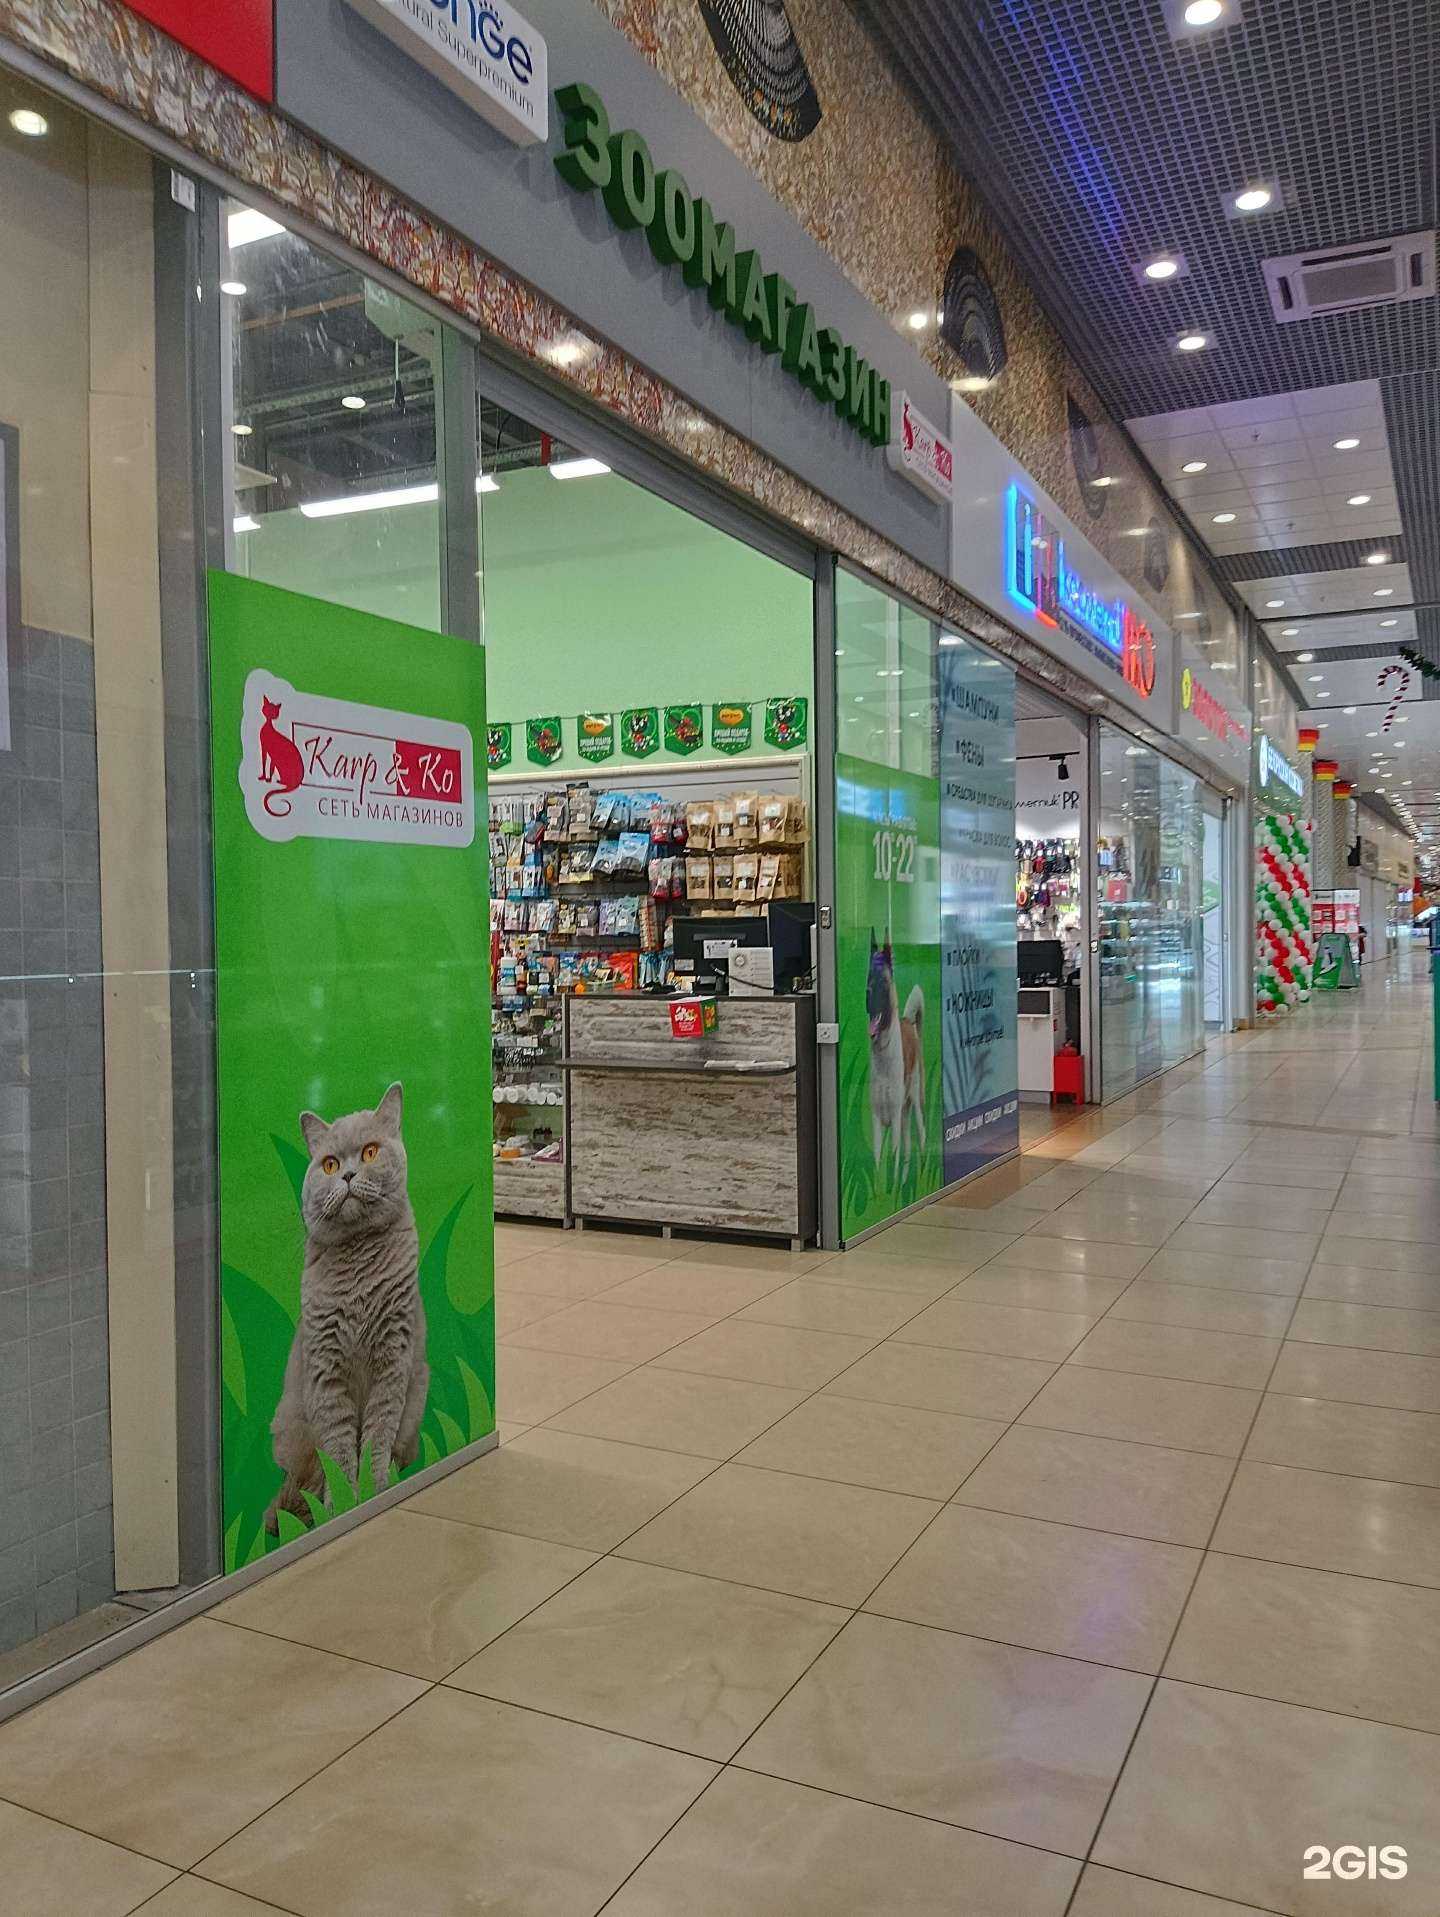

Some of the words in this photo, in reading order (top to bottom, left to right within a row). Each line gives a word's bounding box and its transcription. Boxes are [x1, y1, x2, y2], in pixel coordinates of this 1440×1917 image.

[553, 82, 891, 447] ЗООМАГАЗИН
[384, 752, 410, 796] &
[318, 797, 360, 817] СЕТЬ
[367, 802, 463, 828] МАГАЗИНОВ
